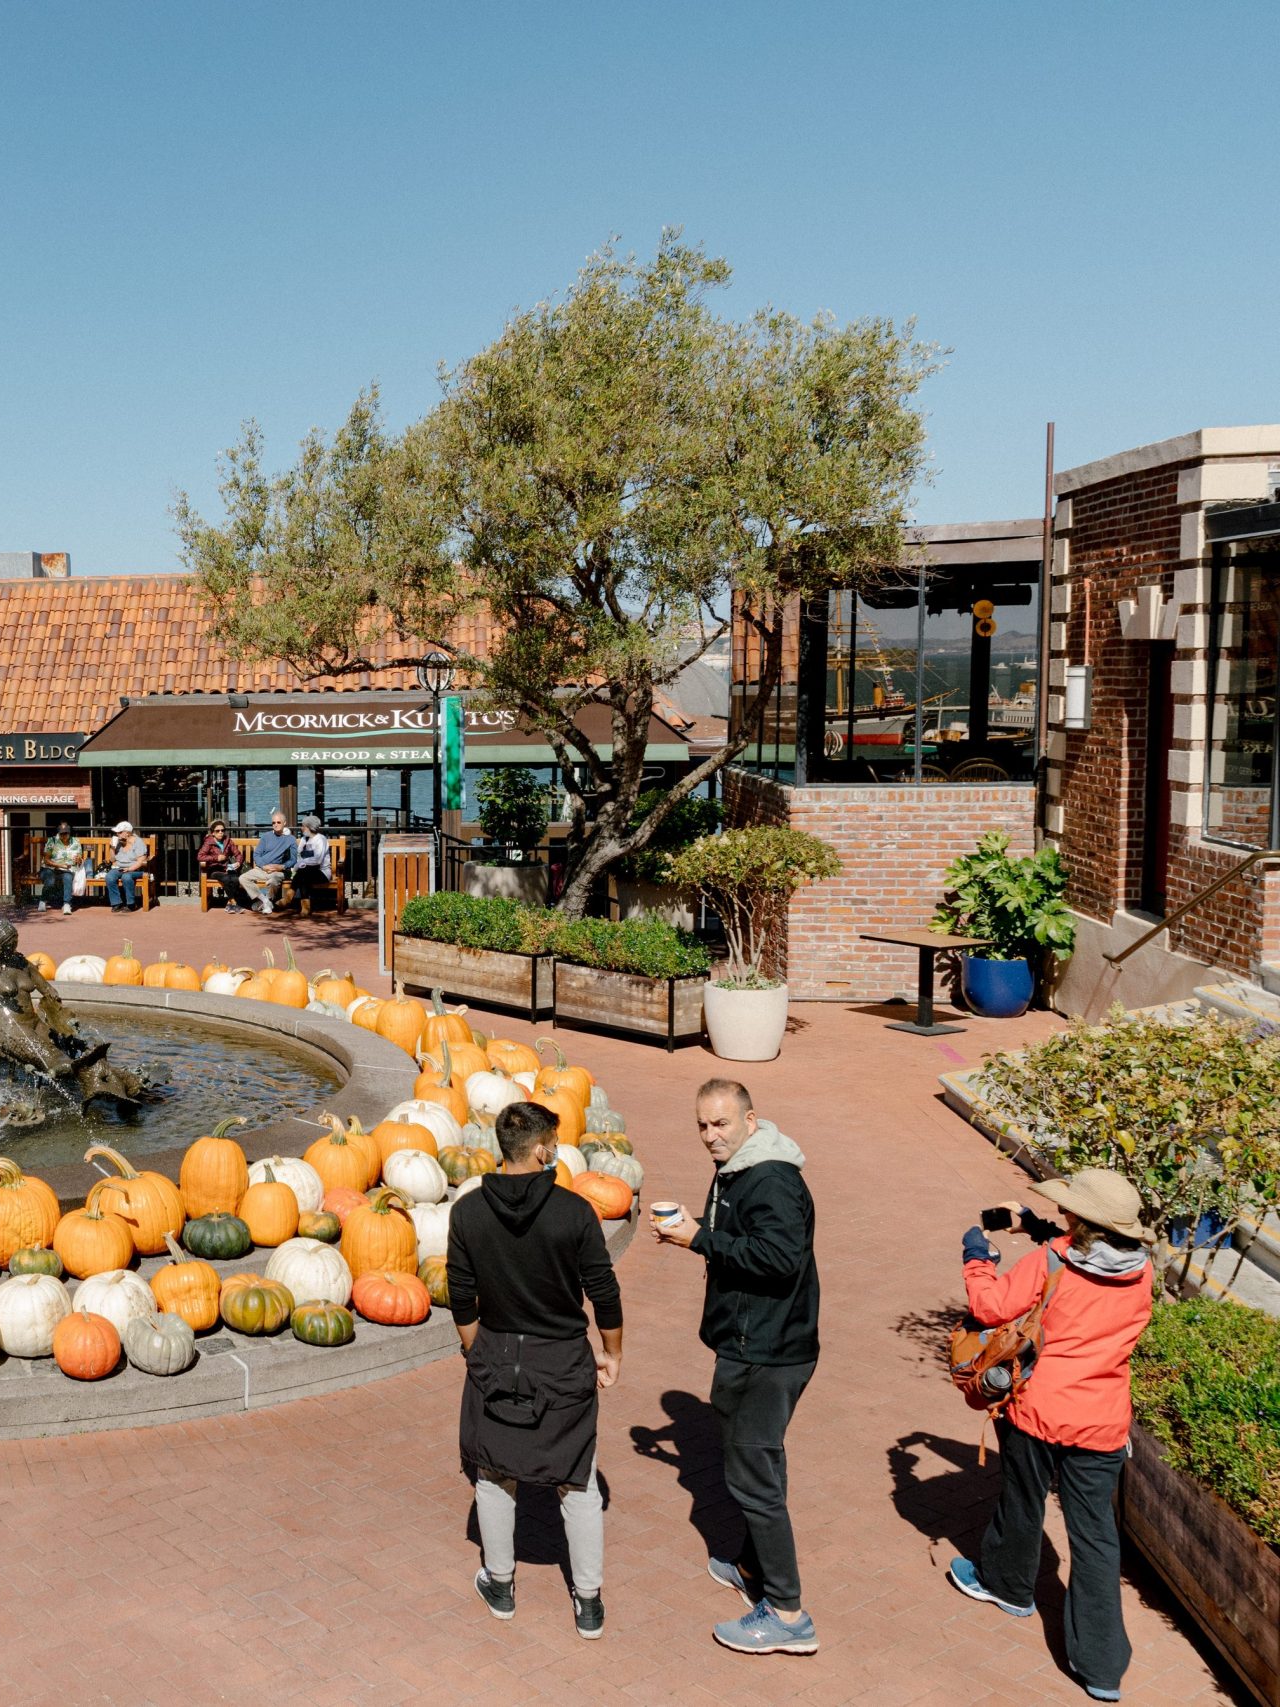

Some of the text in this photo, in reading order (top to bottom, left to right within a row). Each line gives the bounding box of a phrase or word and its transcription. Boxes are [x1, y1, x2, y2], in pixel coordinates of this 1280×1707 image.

[23, 739, 76, 760] BLDG
[290, 751, 370, 761] SEAFOOD
[375, 752, 386, 760] &
[30, 795, 75, 804] GARAGE
